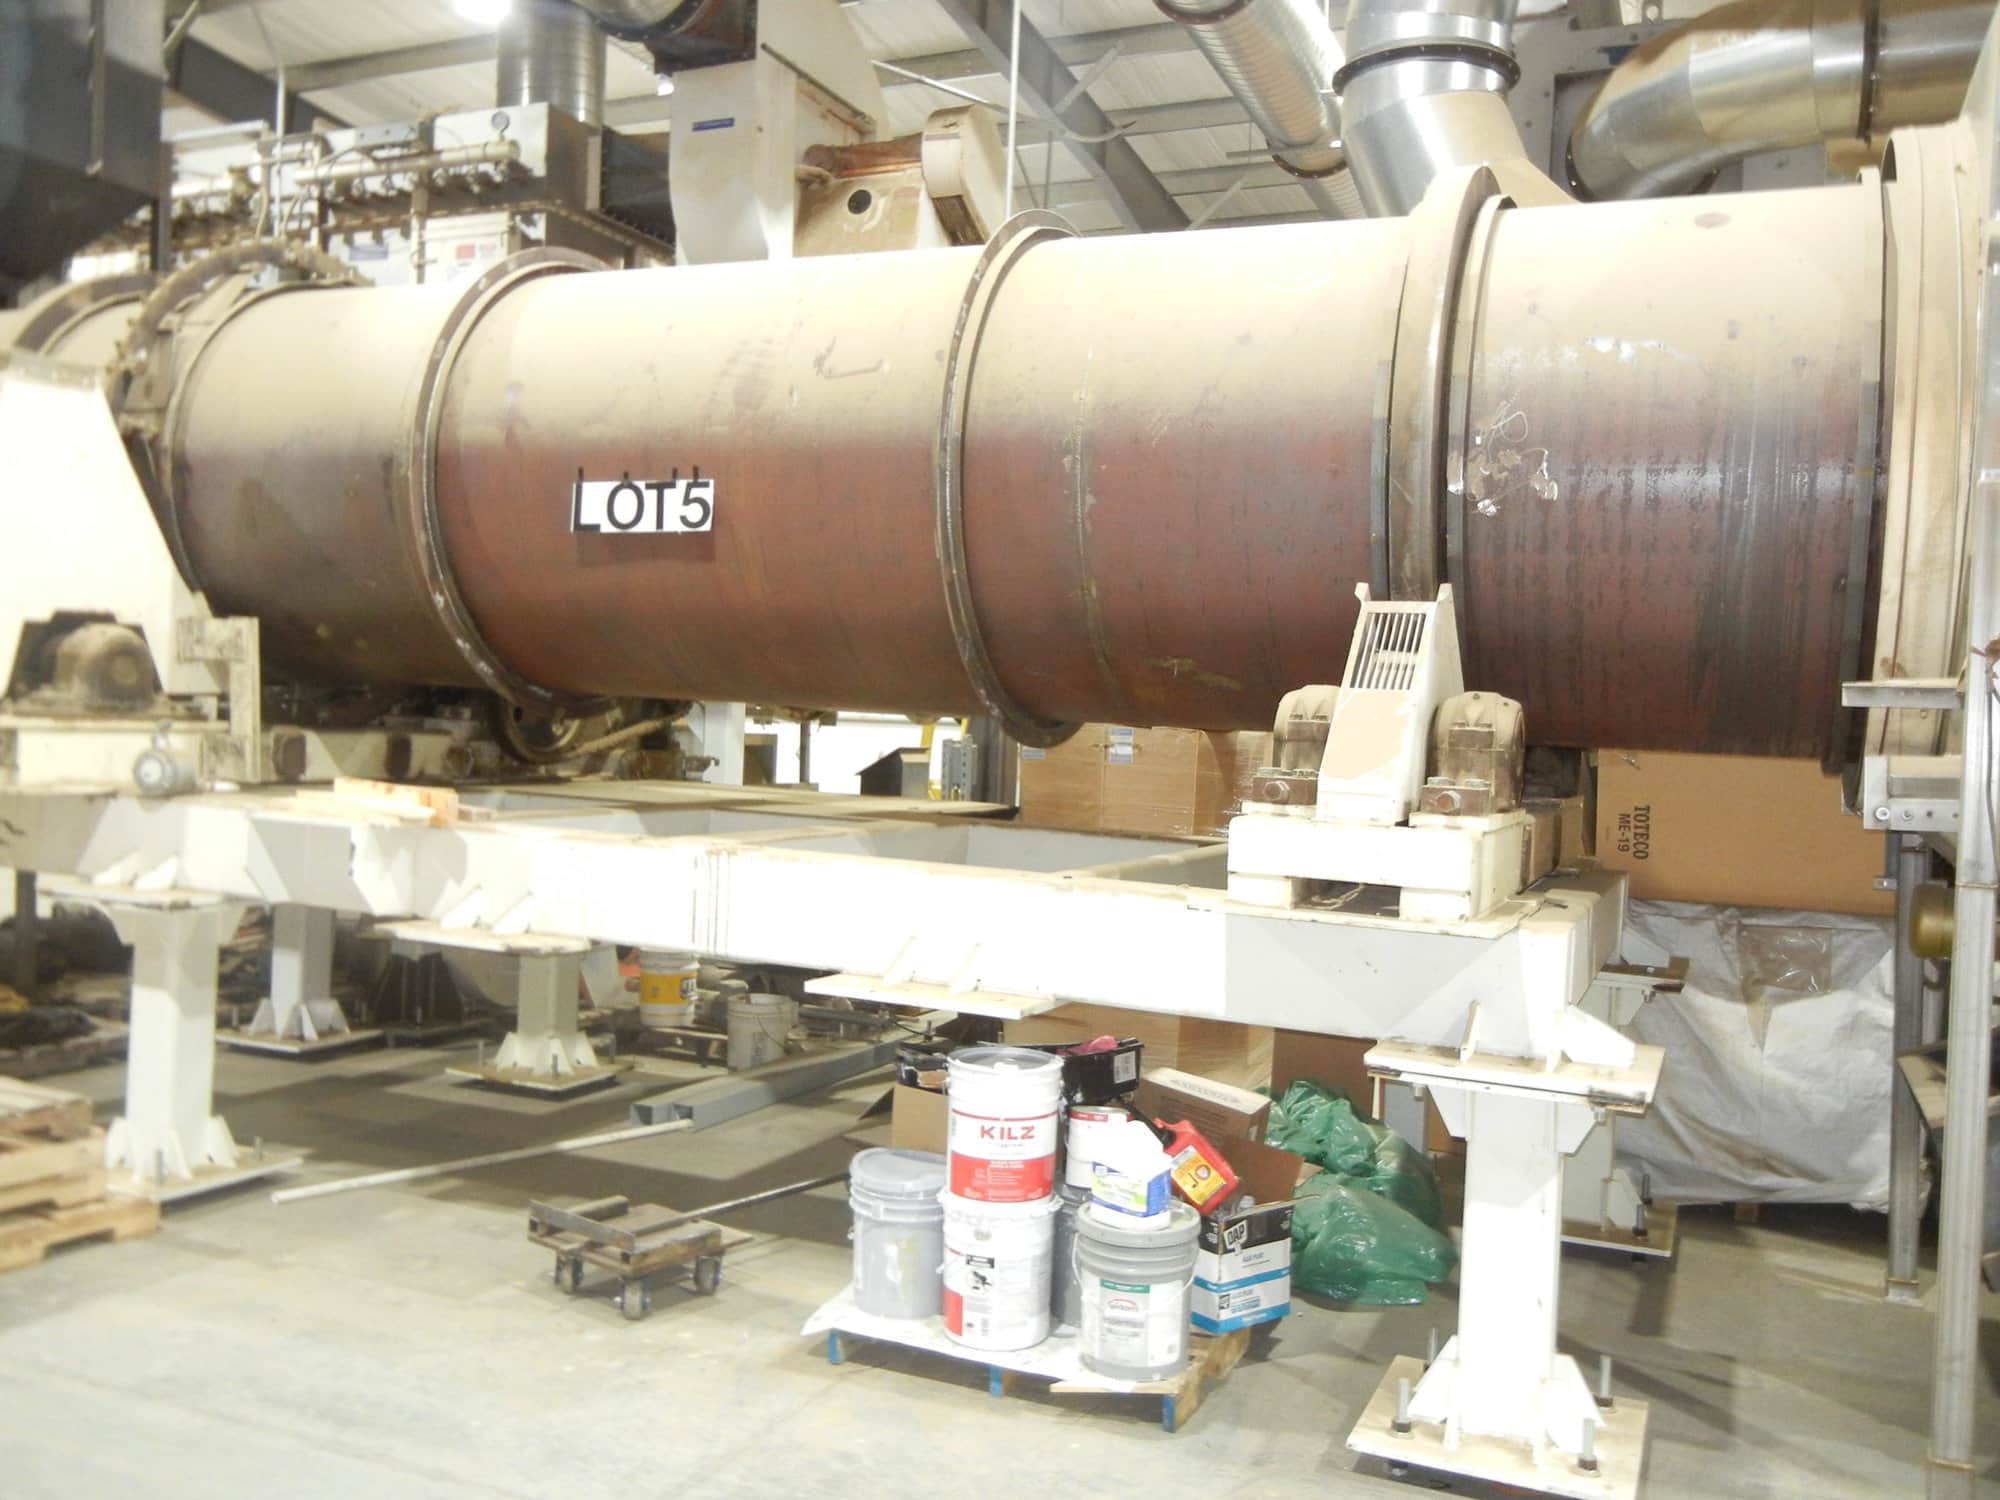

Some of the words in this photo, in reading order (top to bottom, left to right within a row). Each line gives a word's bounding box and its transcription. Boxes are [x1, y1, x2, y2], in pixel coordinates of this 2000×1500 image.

[1617, 813, 1631, 852] ME-19
[1633, 805, 1651, 860] TOTECO
[980, 1125, 1035, 1140] KILZ
[1226, 1223, 1246, 1247] DAP
